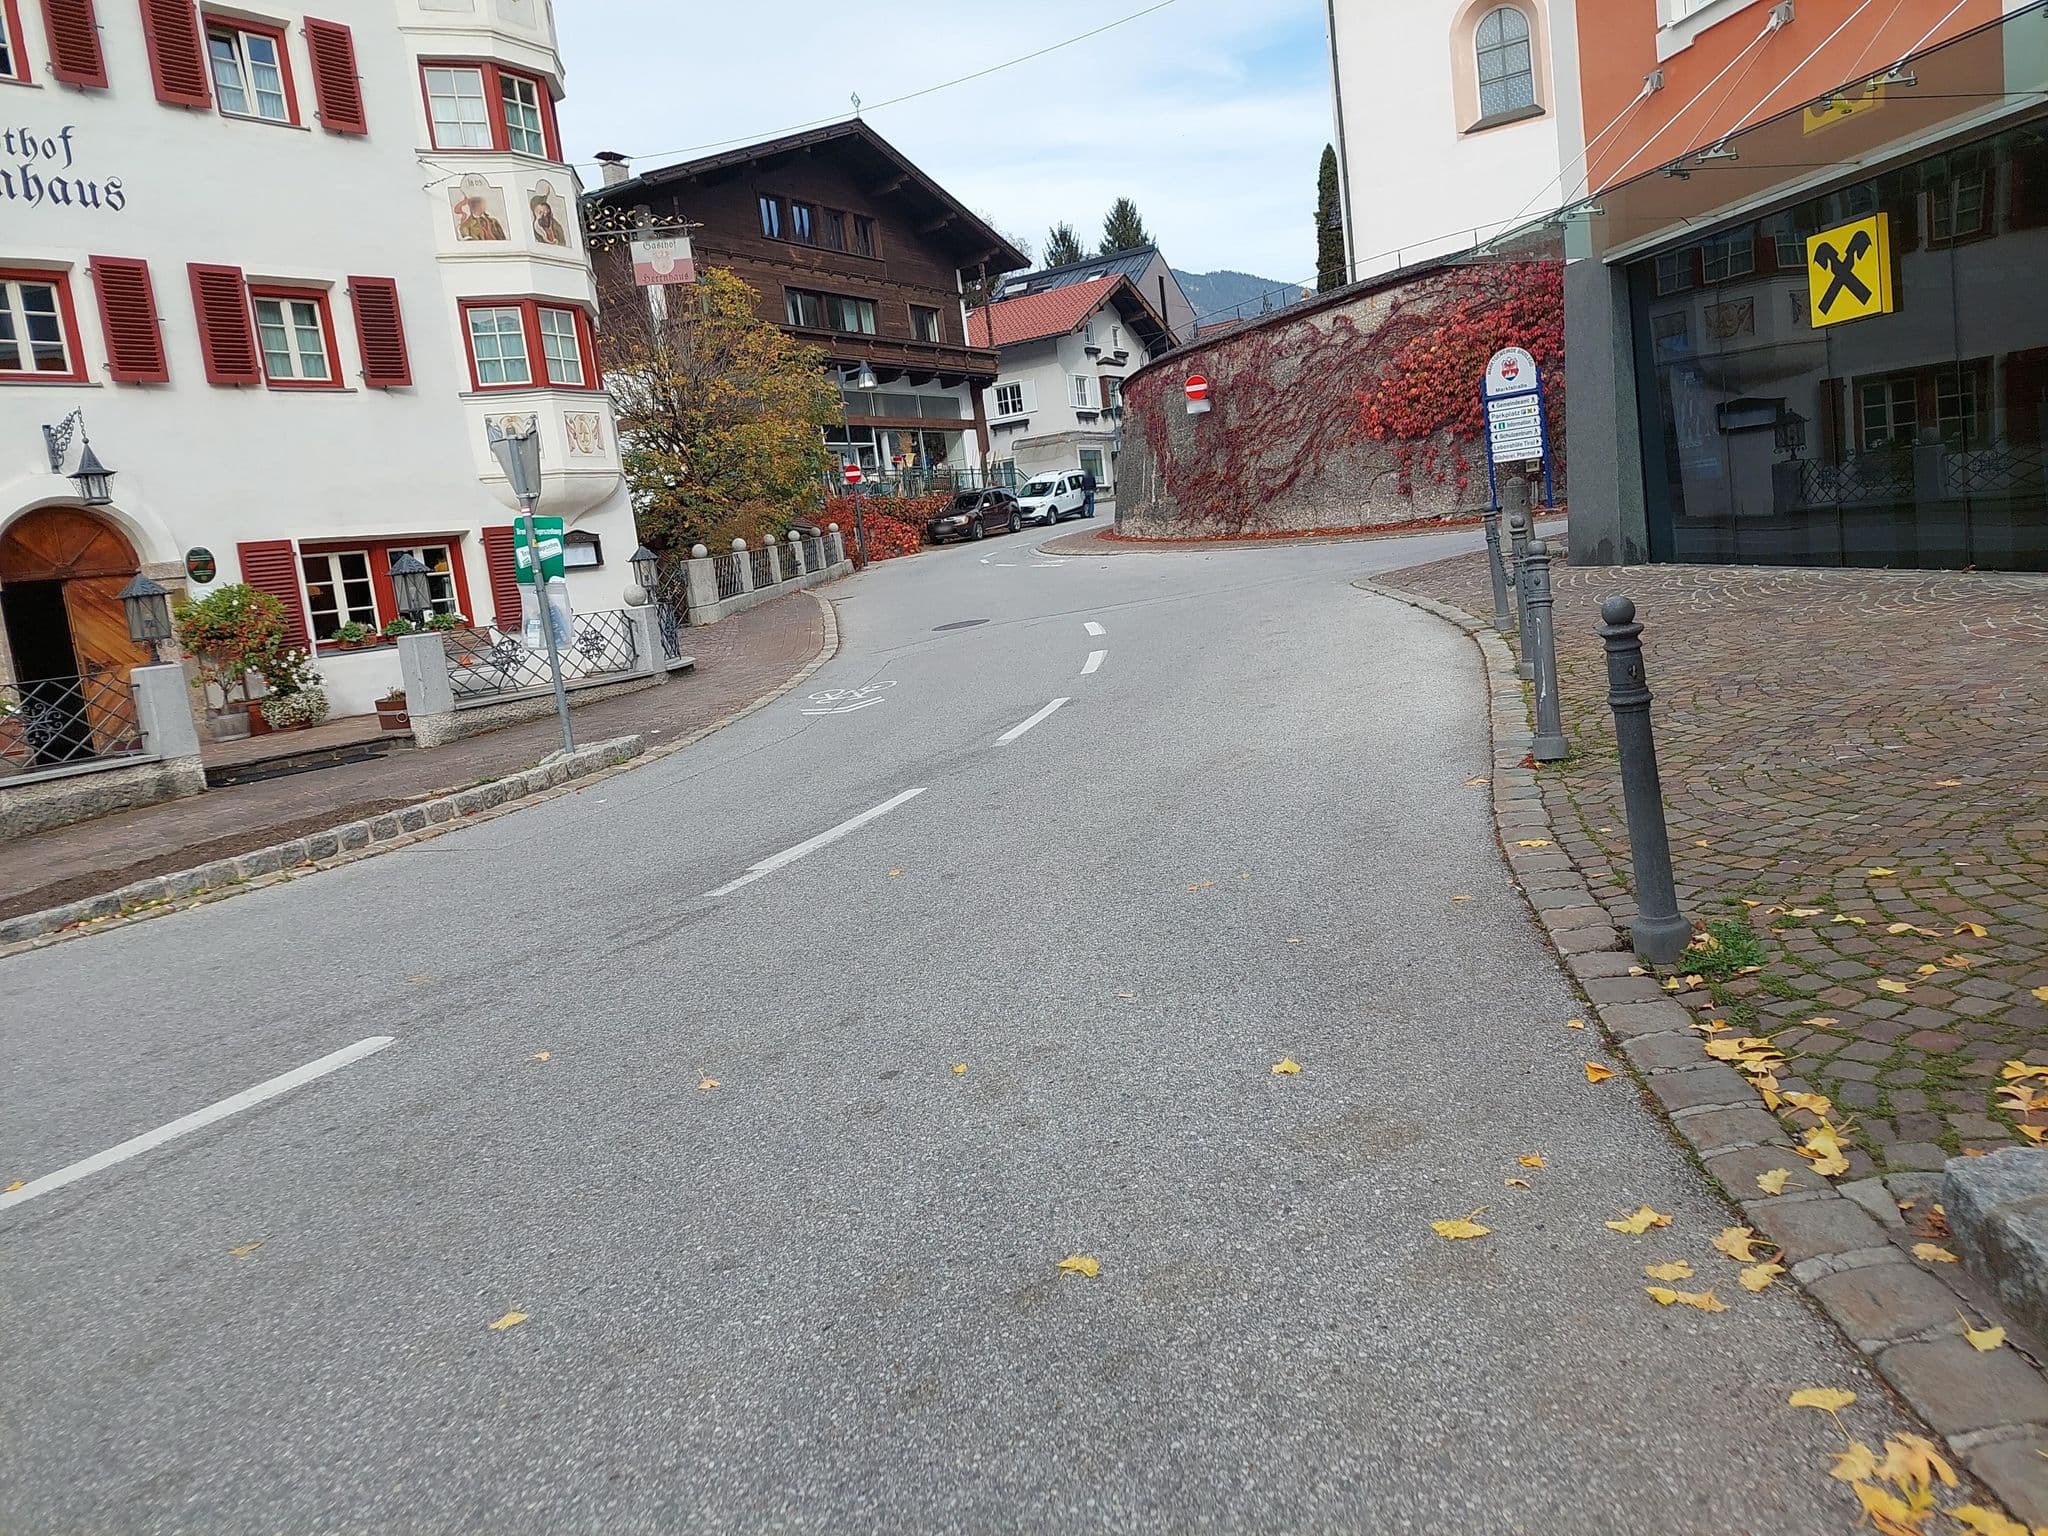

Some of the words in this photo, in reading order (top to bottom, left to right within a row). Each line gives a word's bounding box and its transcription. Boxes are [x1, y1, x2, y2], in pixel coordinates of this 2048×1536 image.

[0, 125, 76, 170] thof
[642, 241, 677, 250] Gasthof
[1496, 399, 1530, 408] Gemeindeamt
[1491, 410, 1521, 419] Parkplatz
[1506, 420, 1532, 428] Information
[1499, 430, 1533, 439] Schulzentrum
